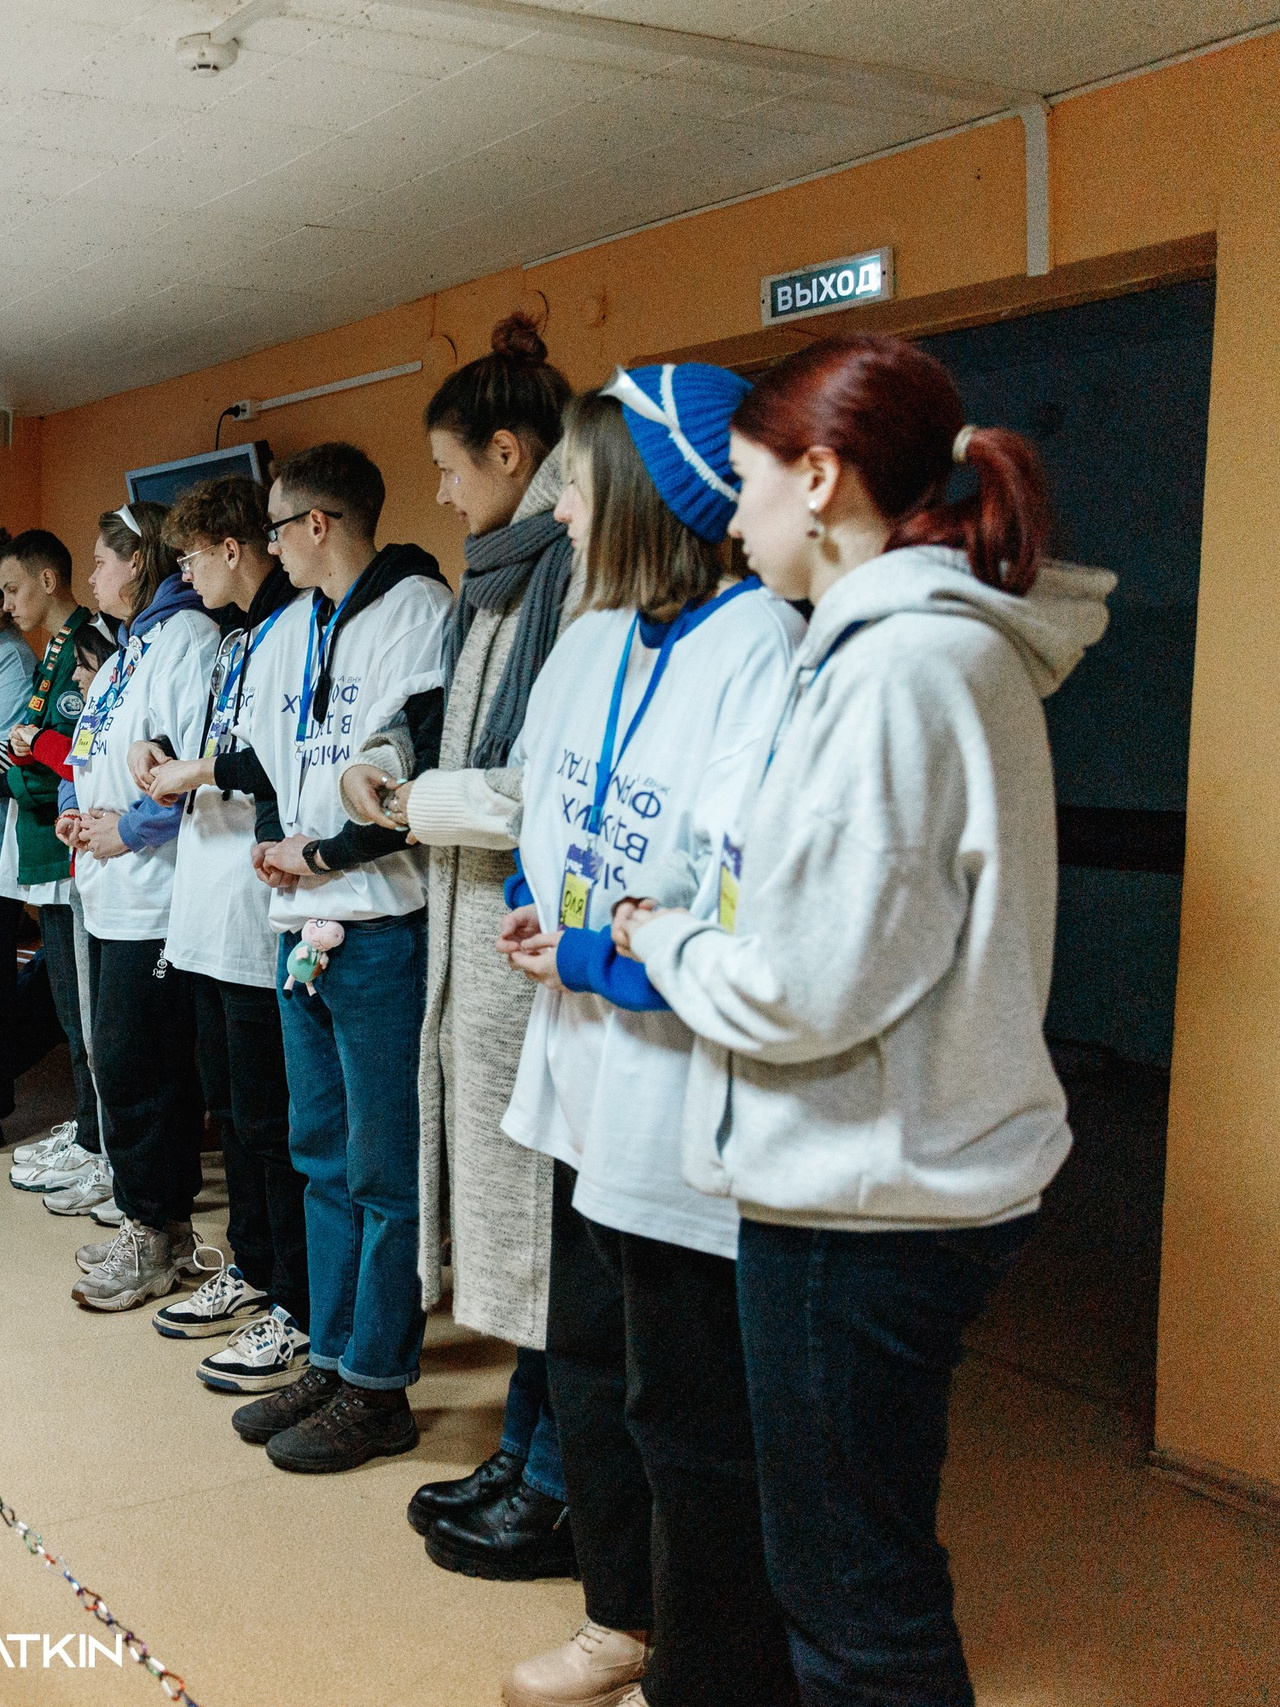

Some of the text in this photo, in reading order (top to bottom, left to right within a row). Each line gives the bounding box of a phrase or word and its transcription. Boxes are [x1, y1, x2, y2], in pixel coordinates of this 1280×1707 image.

[777, 262, 878, 312] ВЫХОД
[341, 714, 353, 735] В
[624, 832, 649, 864] В
